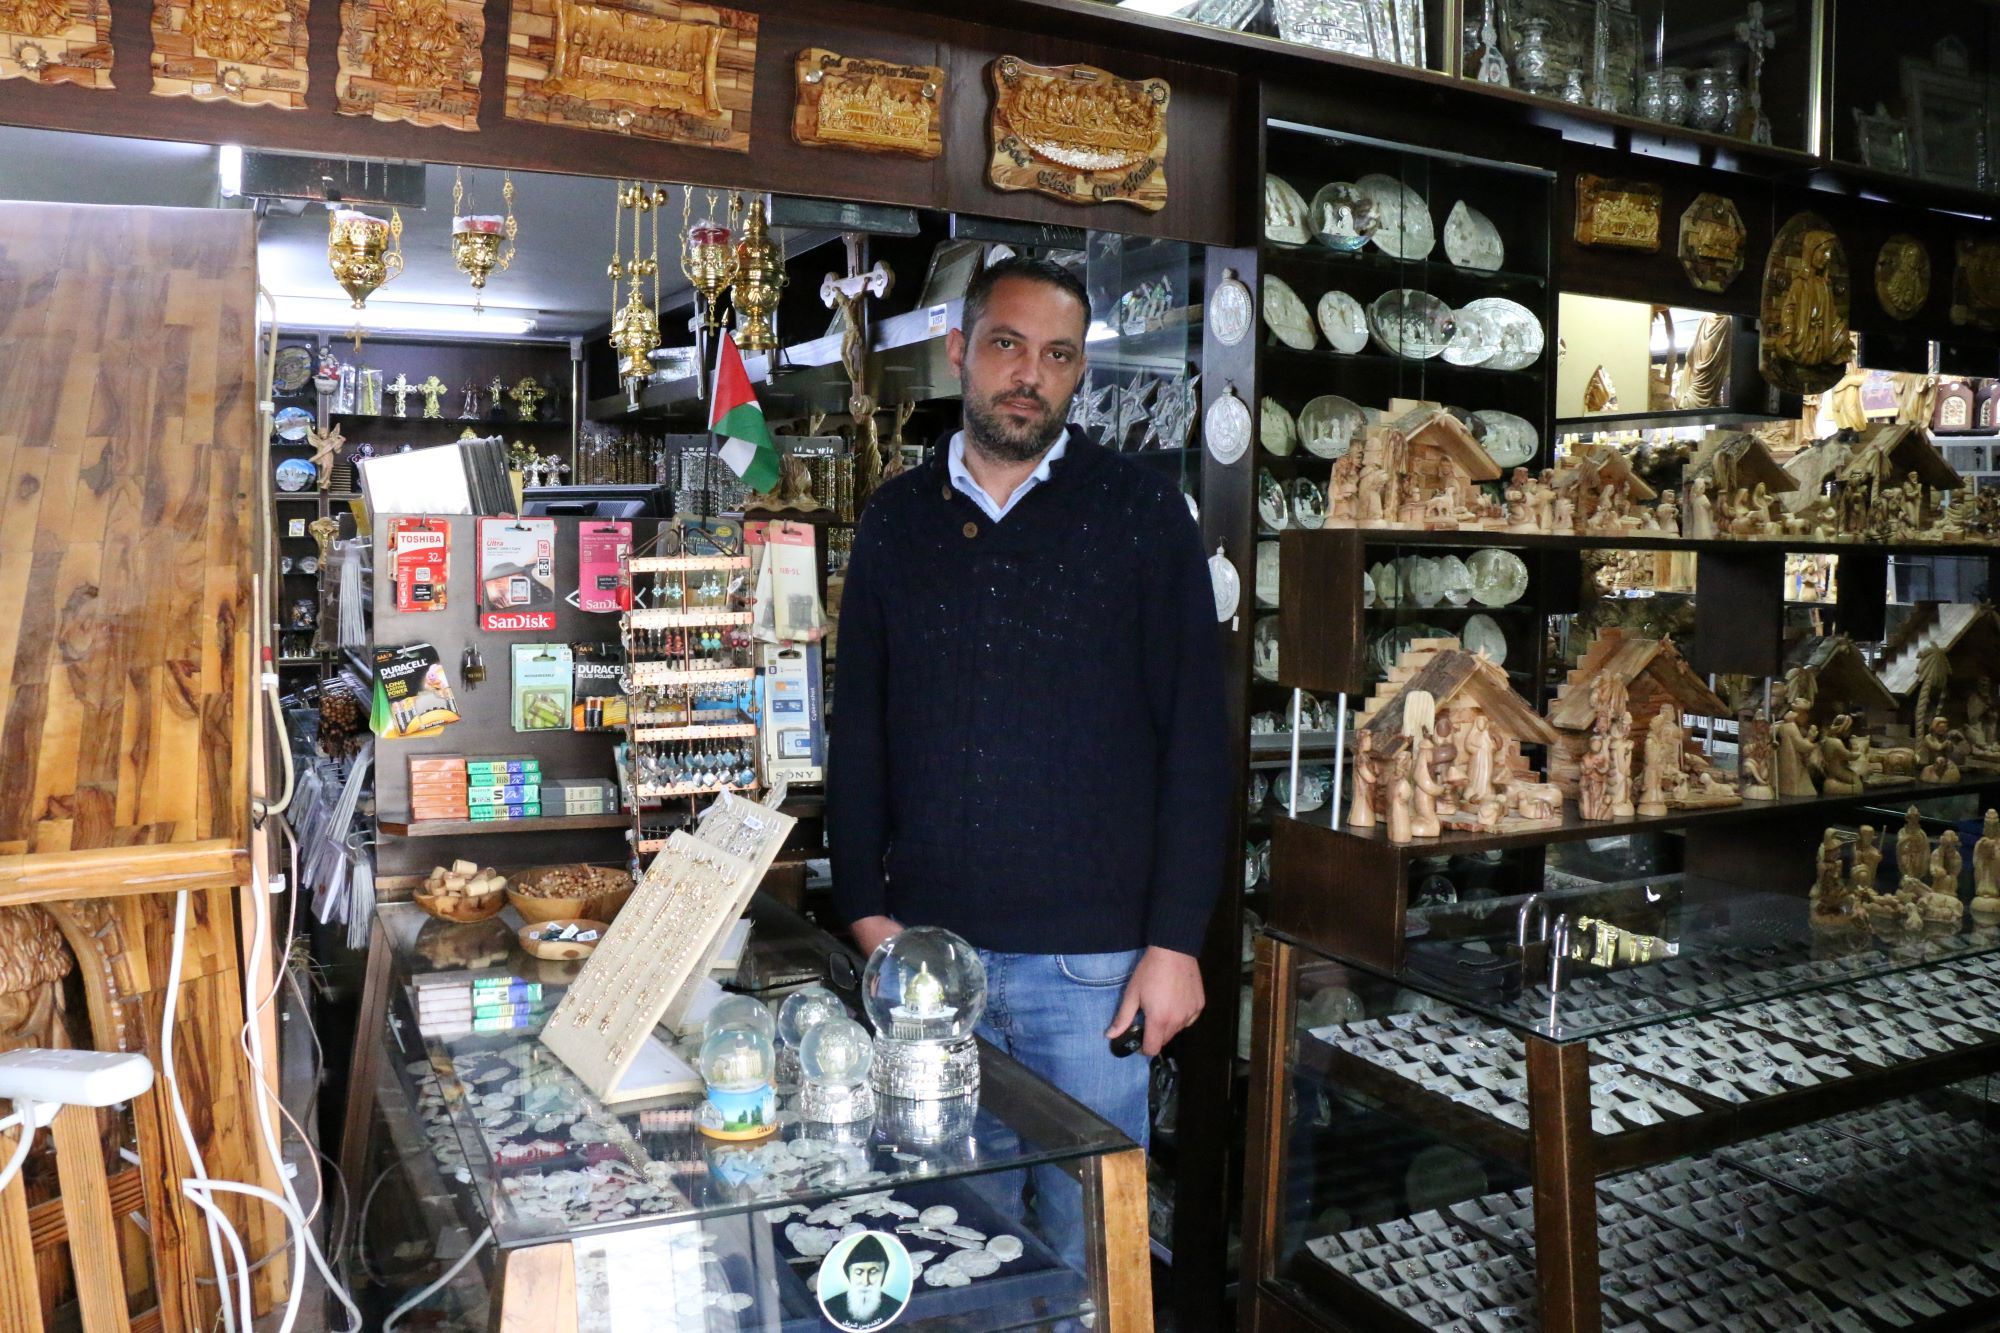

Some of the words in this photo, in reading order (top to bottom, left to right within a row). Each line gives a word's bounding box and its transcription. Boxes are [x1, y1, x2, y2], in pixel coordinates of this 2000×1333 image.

[821, 55, 842, 69] God
[1038, 170, 1076, 194] Bless
[488, 615, 550, 629] SanDisk
[380, 659, 428, 678] DURACELL
[397, 668, 415, 677] POWER
[385, 680, 405, 688] LONG
[810, 687, 818, 721] Cyber-shot
[493, 764, 505, 772] Hi8
[529, 774, 538, 782] 30
[776, 771, 814, 779] SONY
[495, 807, 507, 815] Hi8
